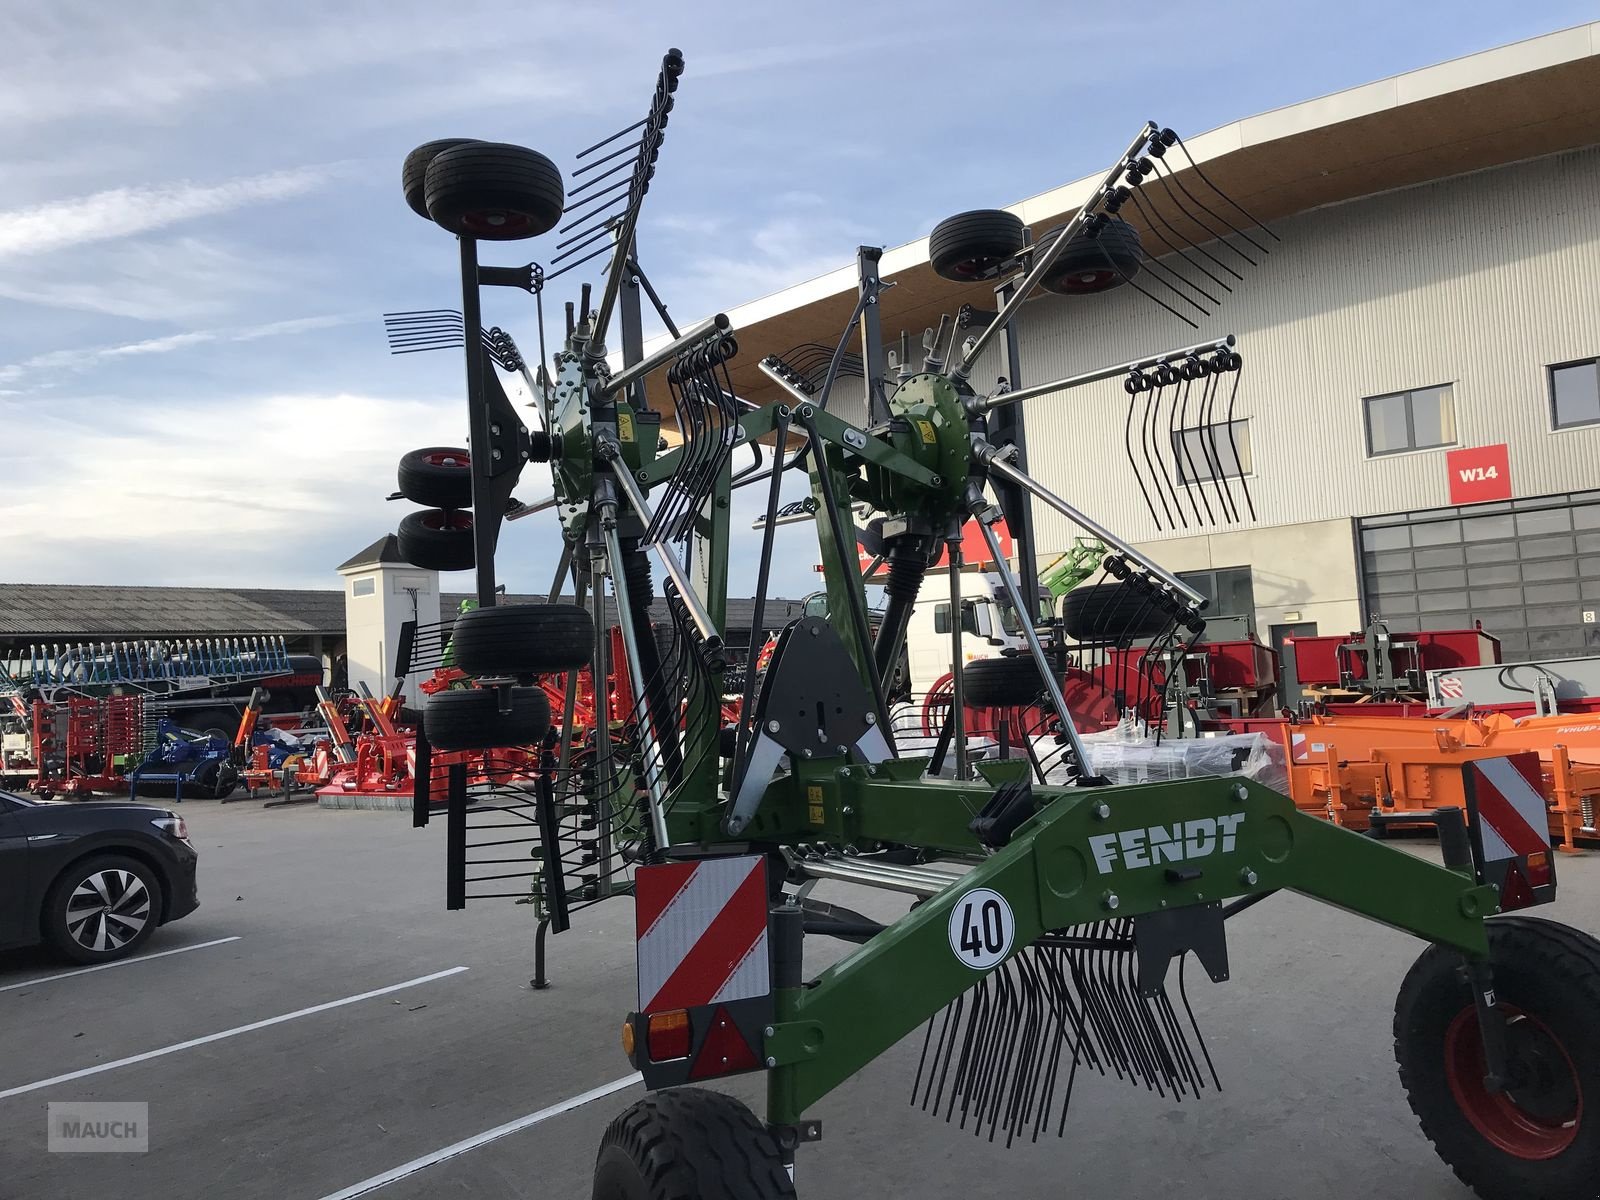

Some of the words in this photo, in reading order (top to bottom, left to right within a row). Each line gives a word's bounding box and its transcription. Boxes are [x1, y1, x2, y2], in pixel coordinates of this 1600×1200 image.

[1459, 465, 1498, 483] W14
[1585, 612, 1593, 622] 8
[1088, 812, 1246, 875] FENDT
[960, 899, 1004, 958] 40
